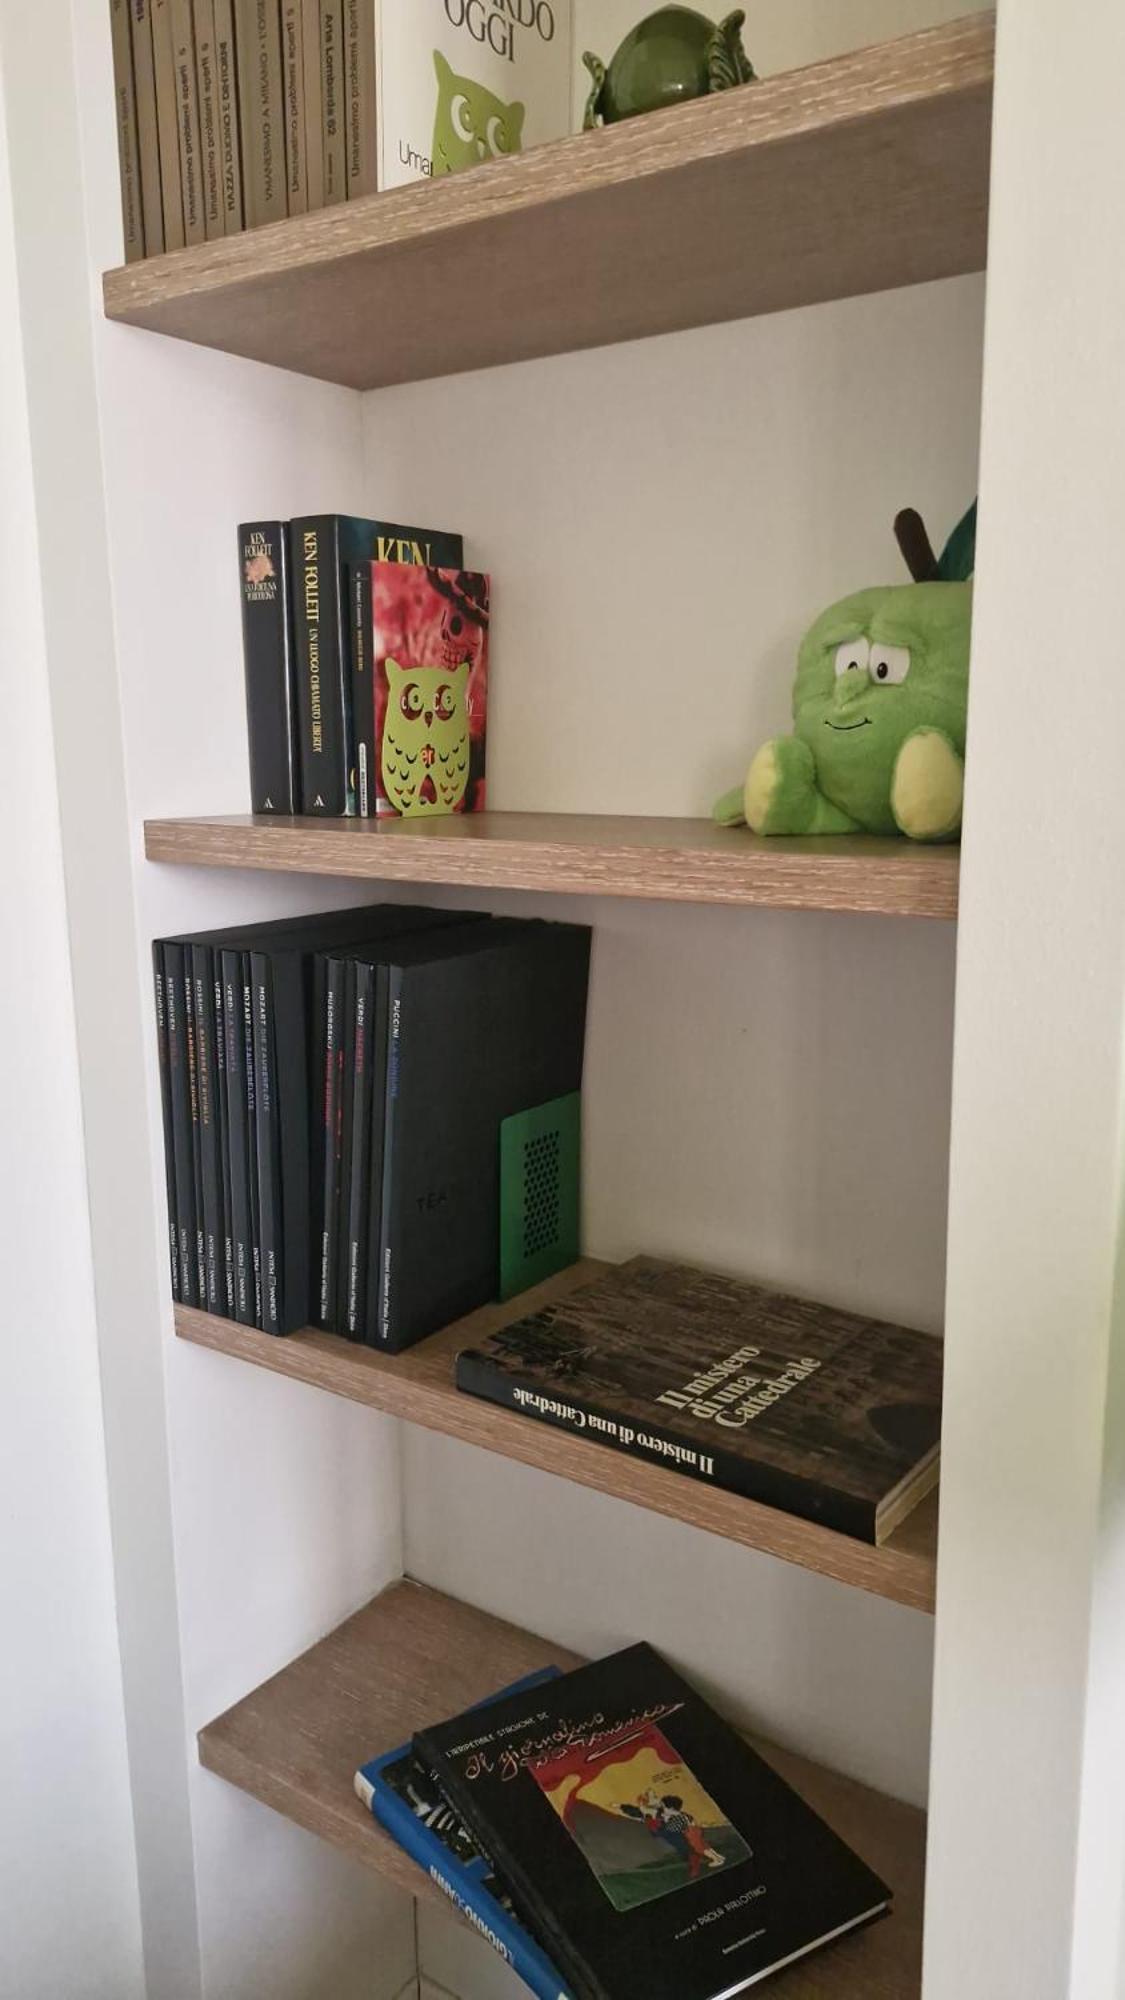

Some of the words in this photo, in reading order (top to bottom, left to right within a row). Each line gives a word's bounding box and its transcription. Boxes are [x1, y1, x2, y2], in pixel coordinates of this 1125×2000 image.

[445, 0, 515, 63] OGGI
[201, 57, 212, 93] aperti
[260, 53, 269, 104] MILANO
[289, 63, 299, 116] problemi
[349, 42, 359, 98] problemi
[183, 103, 193, 155] problemi
[204, 97, 215, 149] problemi
[262, 107, 271, 119] A
[224, 114, 233, 162] DUOMO
[351, 102, 361, 178] Umanesimo
[186, 157, 197, 226] Umanesimo
[207, 151, 219, 221] Umanesimo
[304, 532, 318, 561] KEN
[305, 566, 320, 622] FOLLETT
[309, 628, 319, 641] UN
[310, 643, 320, 673] LUOGO
[311, 675, 321, 720] CHIAMATO
[243, 986, 251, 1025] MOZART
[258, 986, 266, 1025] MOZART
[392, 1000, 401, 1038] PUCCINI
[199, 1028, 207, 1072] BARBIERE
[656, 1390, 693, 1410] Il
[682, 1346, 761, 1396] mistero
[688, 1398, 724, 1419] di
[712, 1375, 761, 1403] una
[715, 1357, 822, 1428] Cattedrale
[513, 1387, 587, 1428] Cattedrale
[588, 1414, 618, 1436] una
[618, 1425, 635, 1445] di
[636, 1432, 698, 1465] mistero
[699, 1456, 715, 1476] Il
[501, 1712, 605, 1782] giornalino
